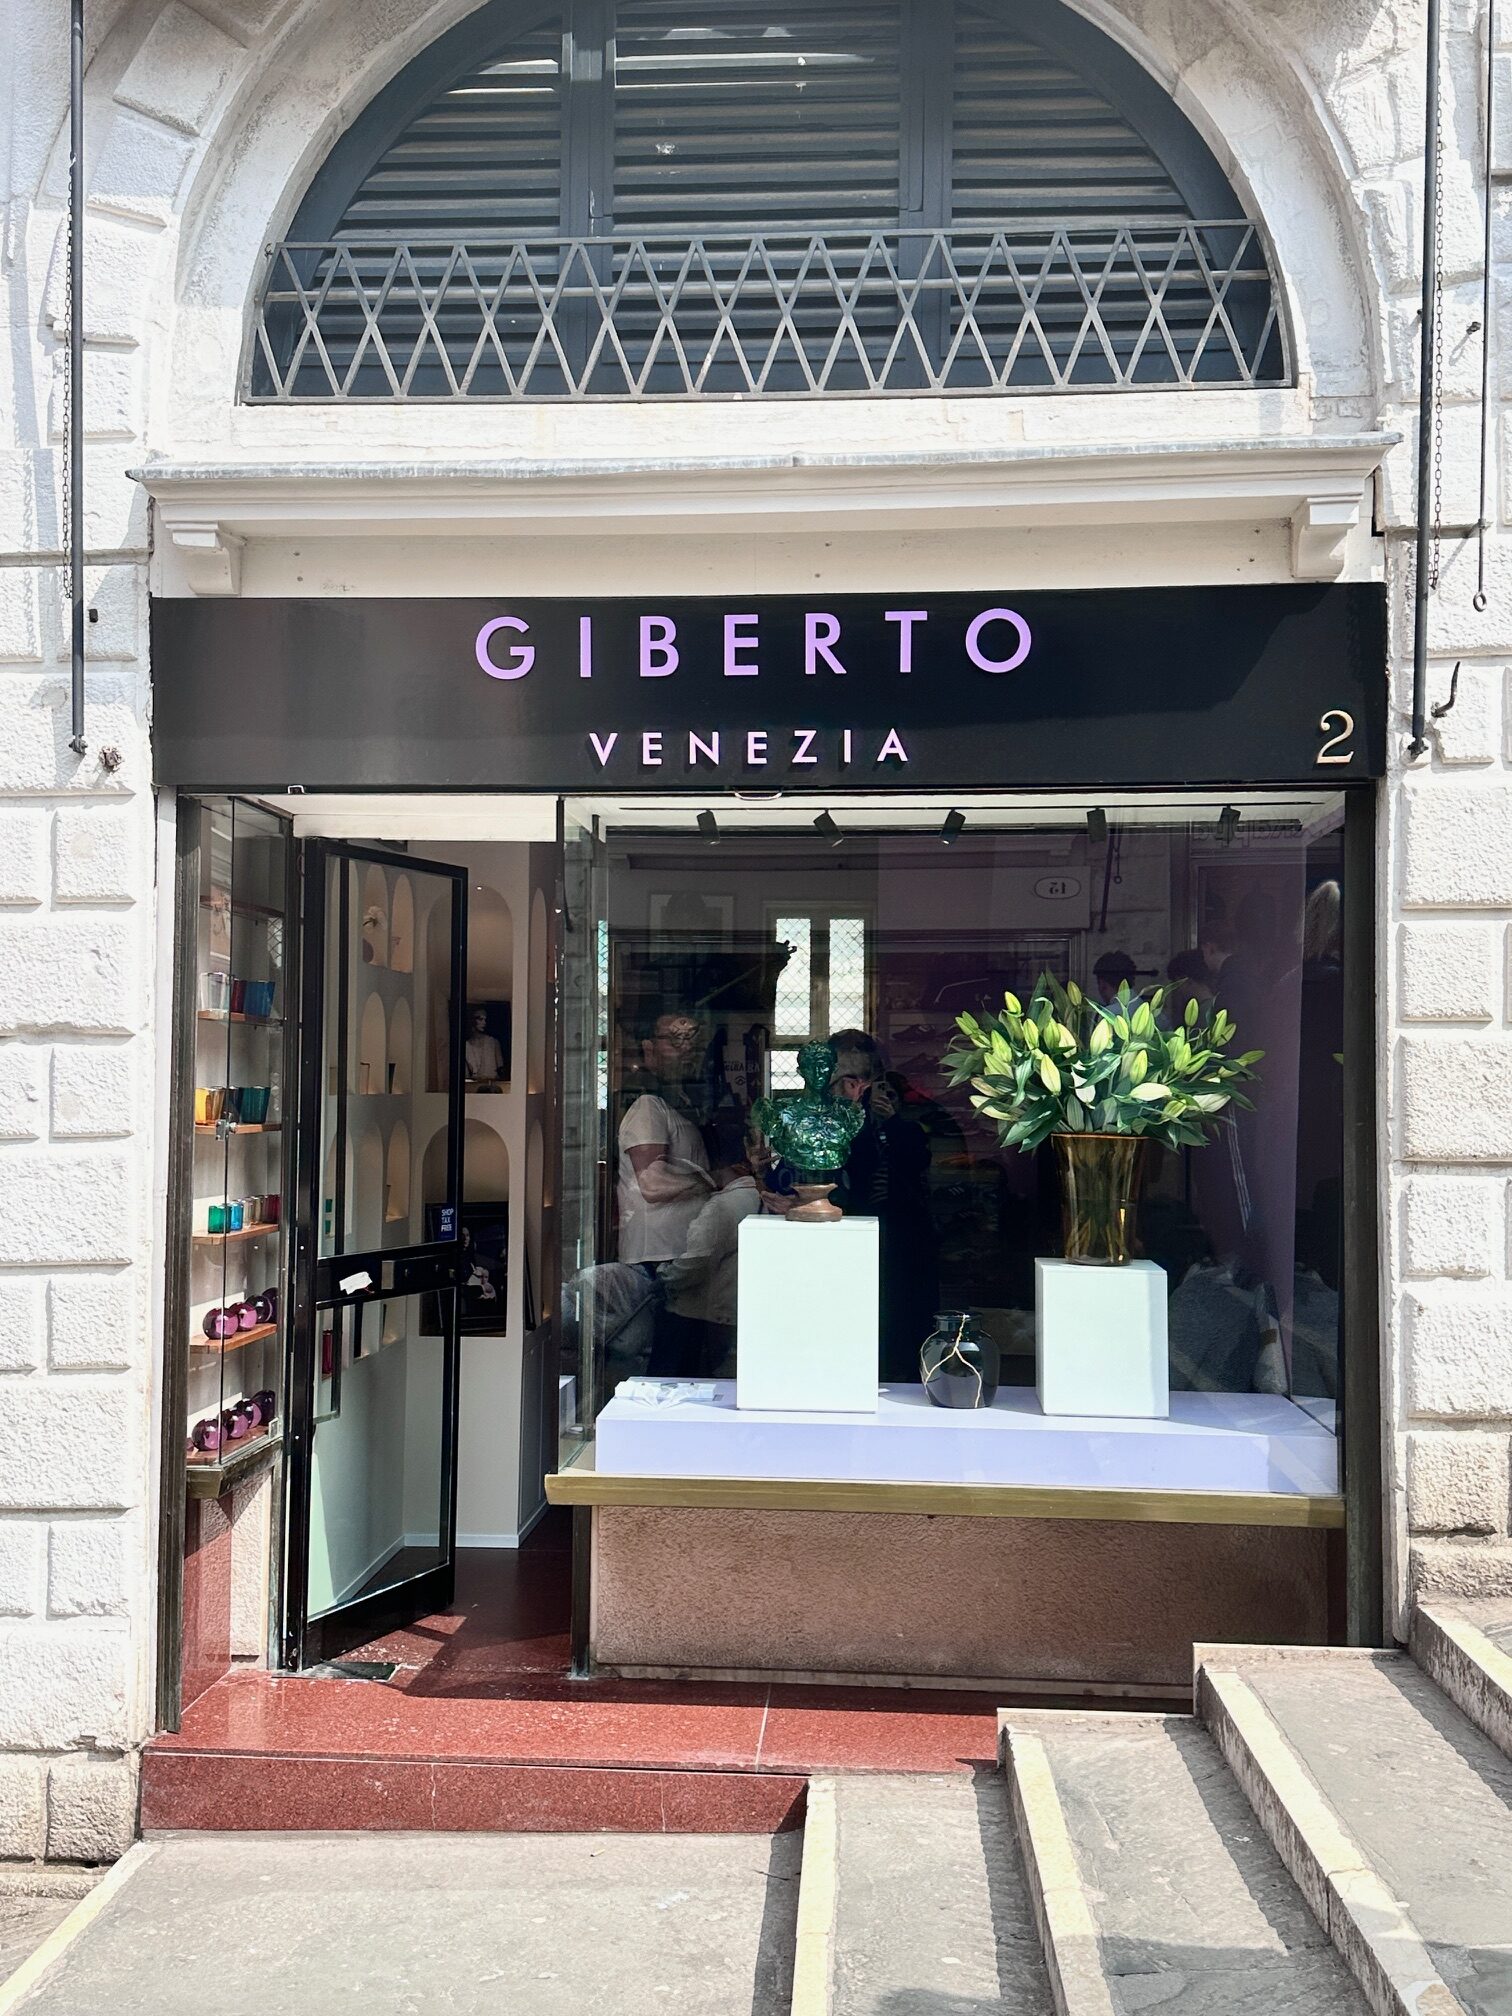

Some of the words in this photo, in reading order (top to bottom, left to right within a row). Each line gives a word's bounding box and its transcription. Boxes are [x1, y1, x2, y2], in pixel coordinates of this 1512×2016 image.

[476, 608, 1031, 679] GIBERTO
[590, 729, 908, 766] VENEZIA
[1317, 710, 1353, 763] 2
[441, 1208, 454, 1216] SHOP
